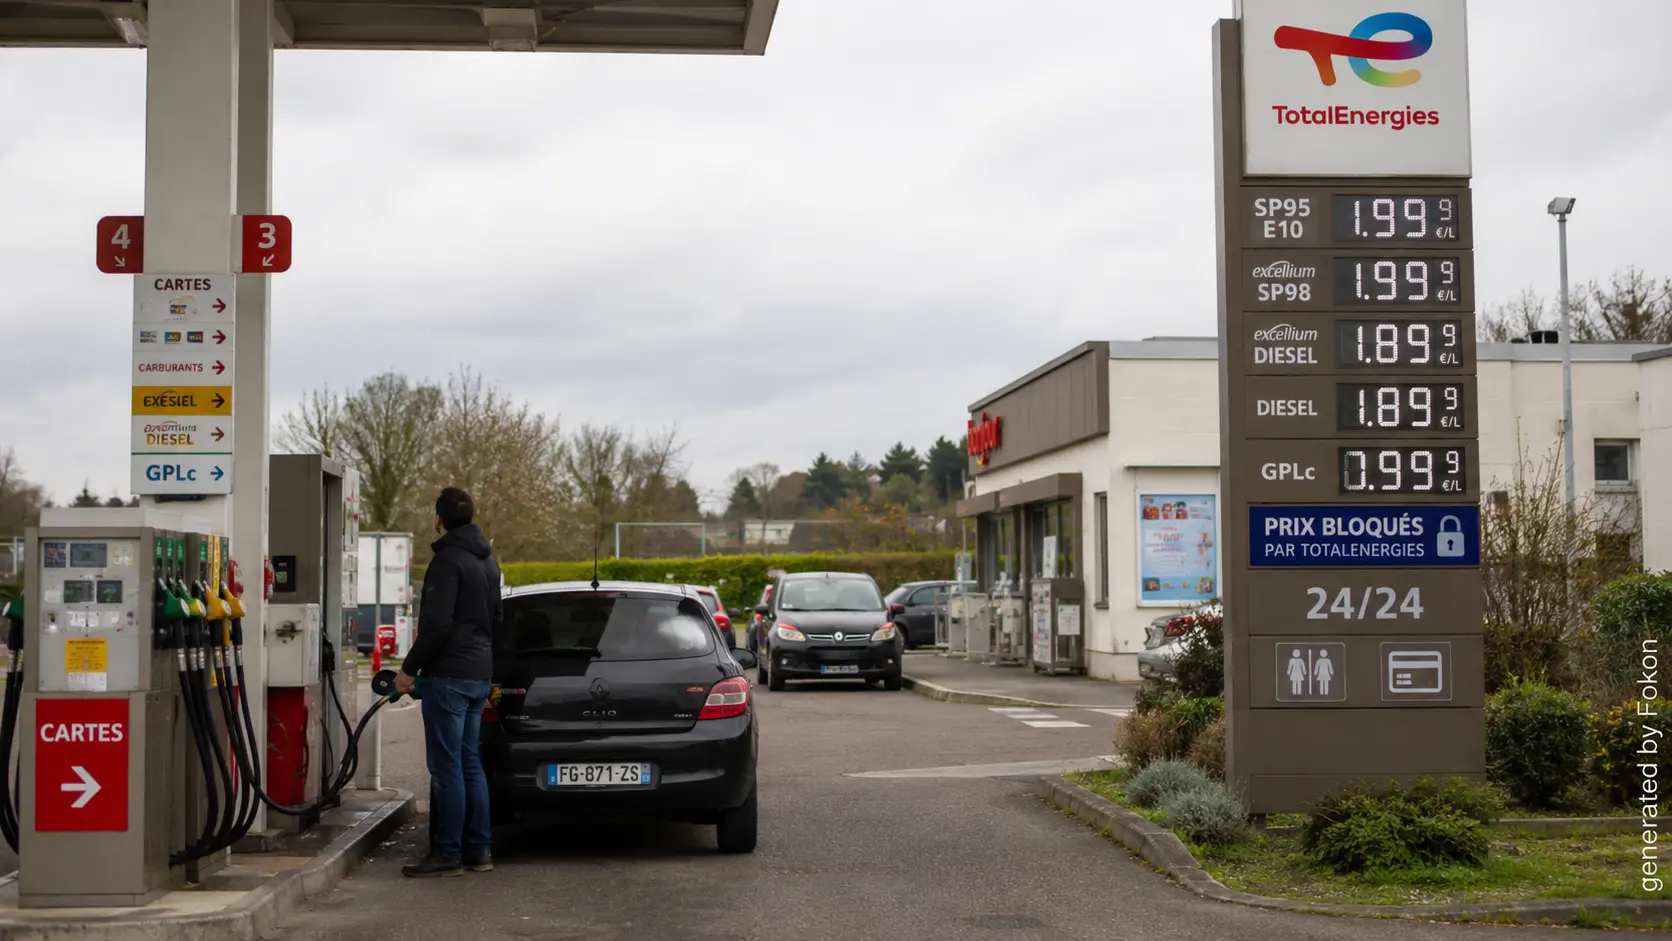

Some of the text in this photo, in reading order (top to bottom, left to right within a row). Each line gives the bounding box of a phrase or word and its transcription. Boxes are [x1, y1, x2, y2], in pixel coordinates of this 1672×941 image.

[1271, 105, 1440, 131] TotalEnergies
[1254, 198, 1311, 217] SP95
[111, 223, 131, 250] 4
[258, 222, 277, 249] 3
[1263, 219, 1304, 239] E10
[1435, 226, 1456, 239] €/L
[1252, 260, 1316, 278] excellium
[154, 278, 212, 291] CARTES
[1257, 282, 1311, 302] SP98
[1437, 289, 1457, 301] €/L
[1253, 323, 1318, 341] excellium
[1254, 346, 1318, 364] DIESEL
[1439, 352, 1459, 365] €/L
[138, 363, 204, 373] CARBURANTS
[1257, 399, 1318, 416] DIESEL
[1439, 415, 1461, 428] €/L
[146, 432, 195, 446] DIESEL
[145, 464, 197, 482] GPLc
[1261, 462, 1316, 481] GPLc
[1441, 479, 1462, 492] €/L
[1265, 512, 1424, 539] PRIX BLOQUÉS
[1265, 542, 1425, 557] PAR TOTALENERGIES
[1306, 586, 1424, 620] 24/24
[581, 709, 618, 718] CLIO
[40, 722, 124, 742] CARTES
[558, 764, 640, 783] FG-871-ZS
